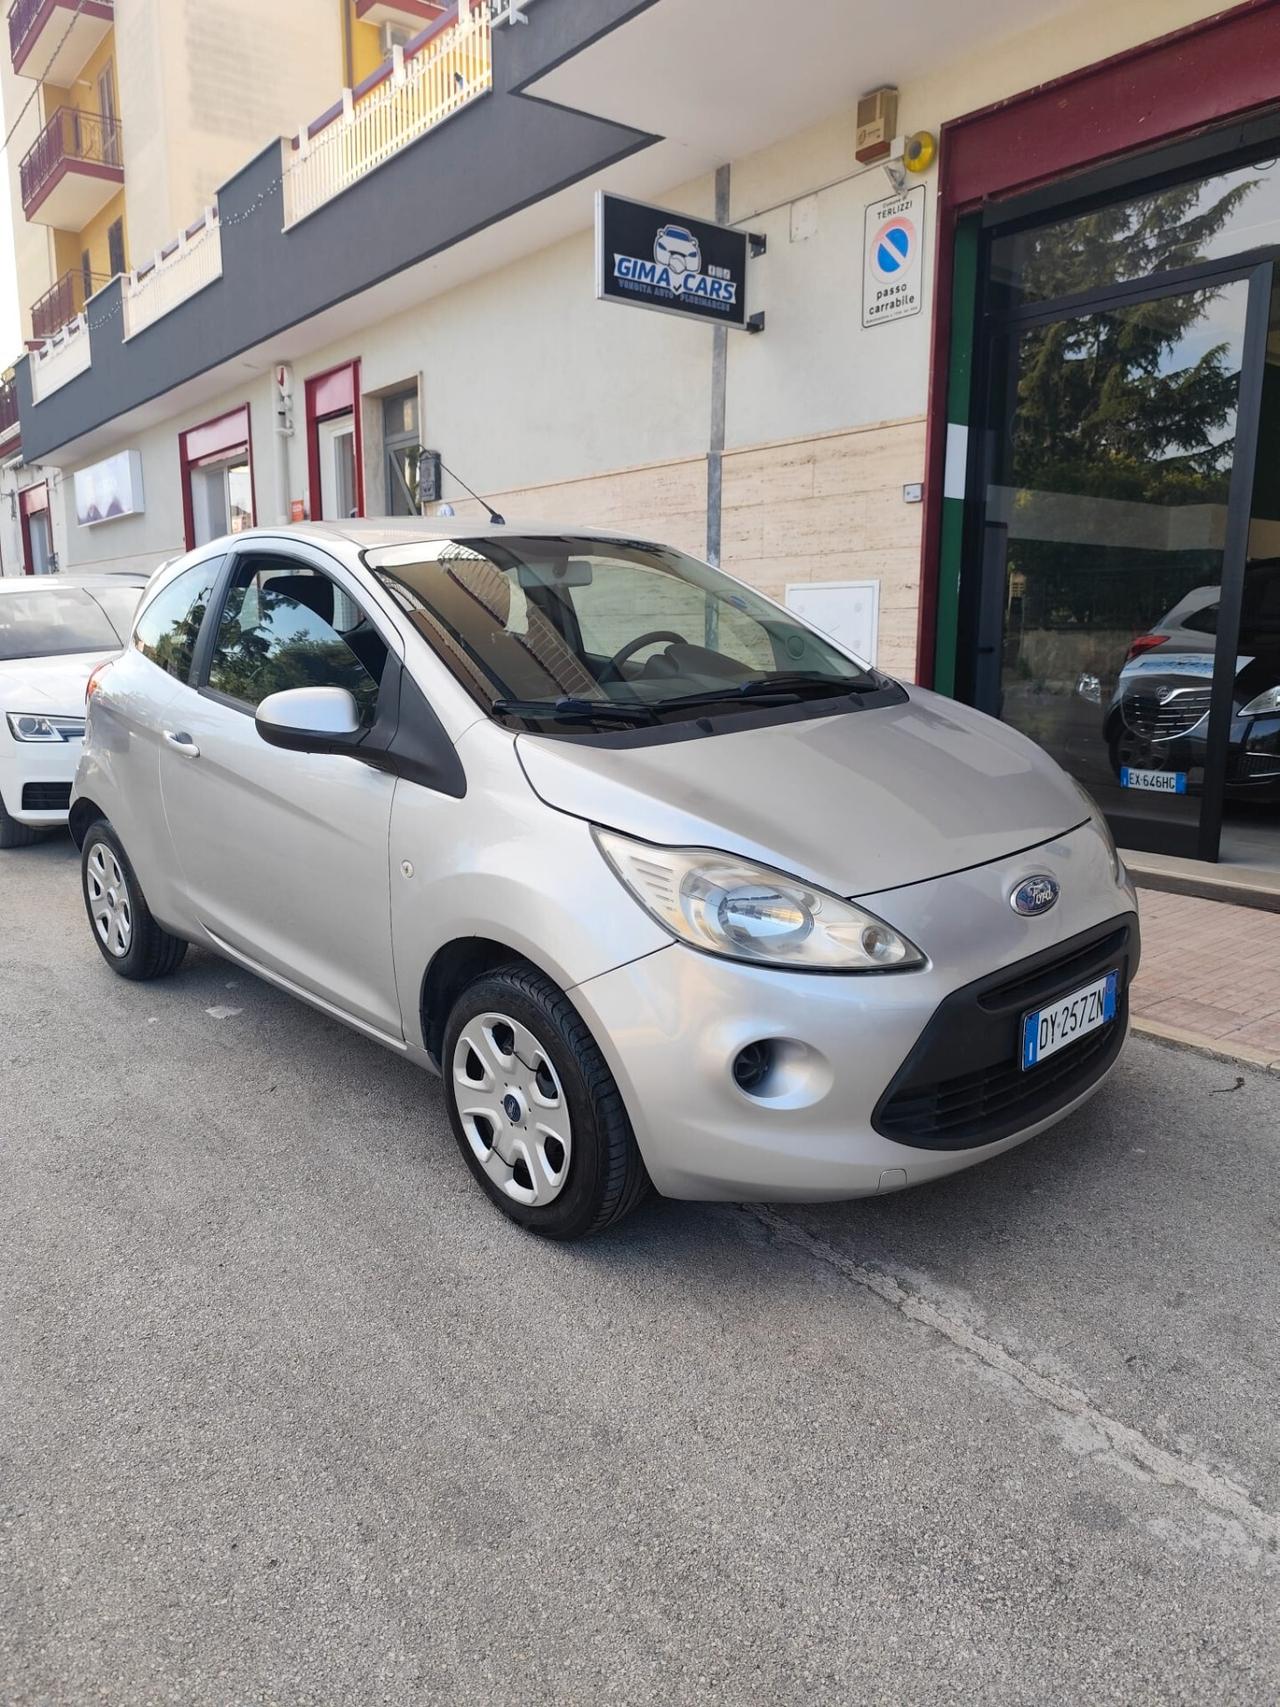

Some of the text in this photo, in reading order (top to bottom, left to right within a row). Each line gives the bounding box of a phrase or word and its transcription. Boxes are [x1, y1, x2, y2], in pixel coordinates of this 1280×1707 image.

[877, 200, 913, 219] TERLIZZI
[617, 257, 734, 301] GIMA CARS
[876, 283, 907, 301] passo
[869, 295, 914, 315] carrabile
[1028, 881, 1053, 907] Ford
